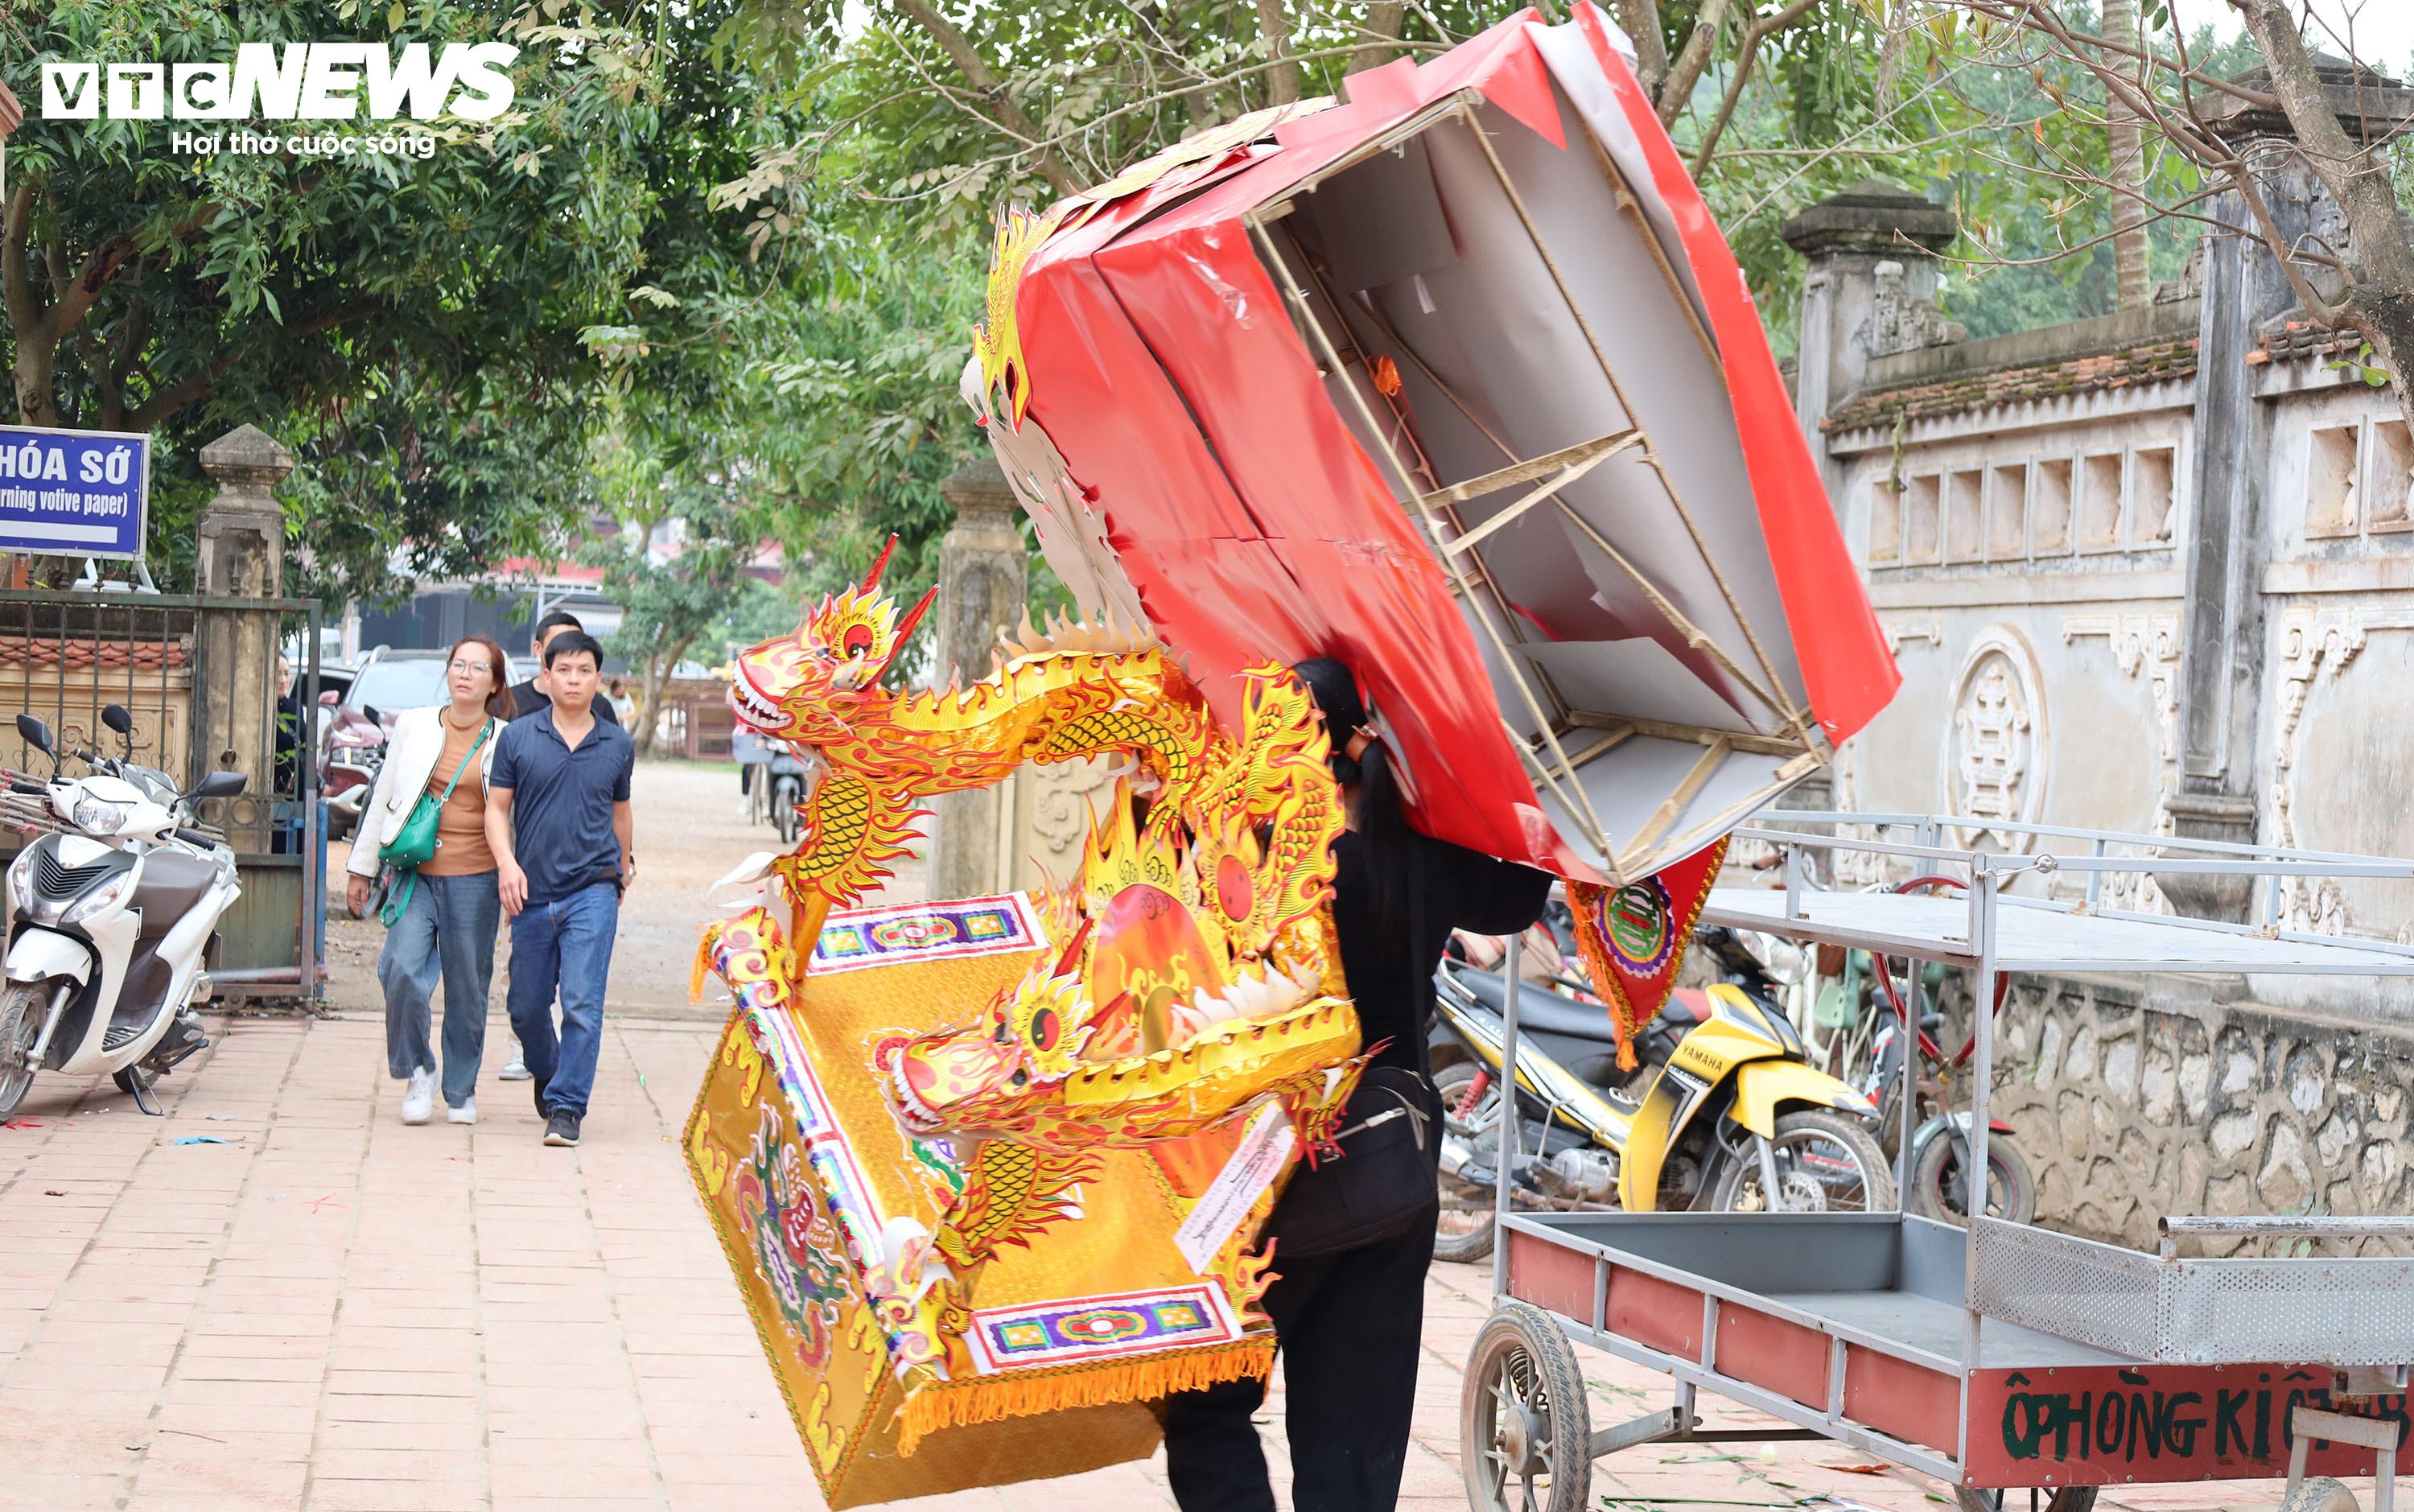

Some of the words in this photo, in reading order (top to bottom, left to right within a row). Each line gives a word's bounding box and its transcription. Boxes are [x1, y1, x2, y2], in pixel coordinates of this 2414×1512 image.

[0, 485, 36, 513] rning
[40, 488, 80, 513] votive
[84, 492, 128, 517] paper)
[1683, 1044, 1723, 1073] YAMAHA
